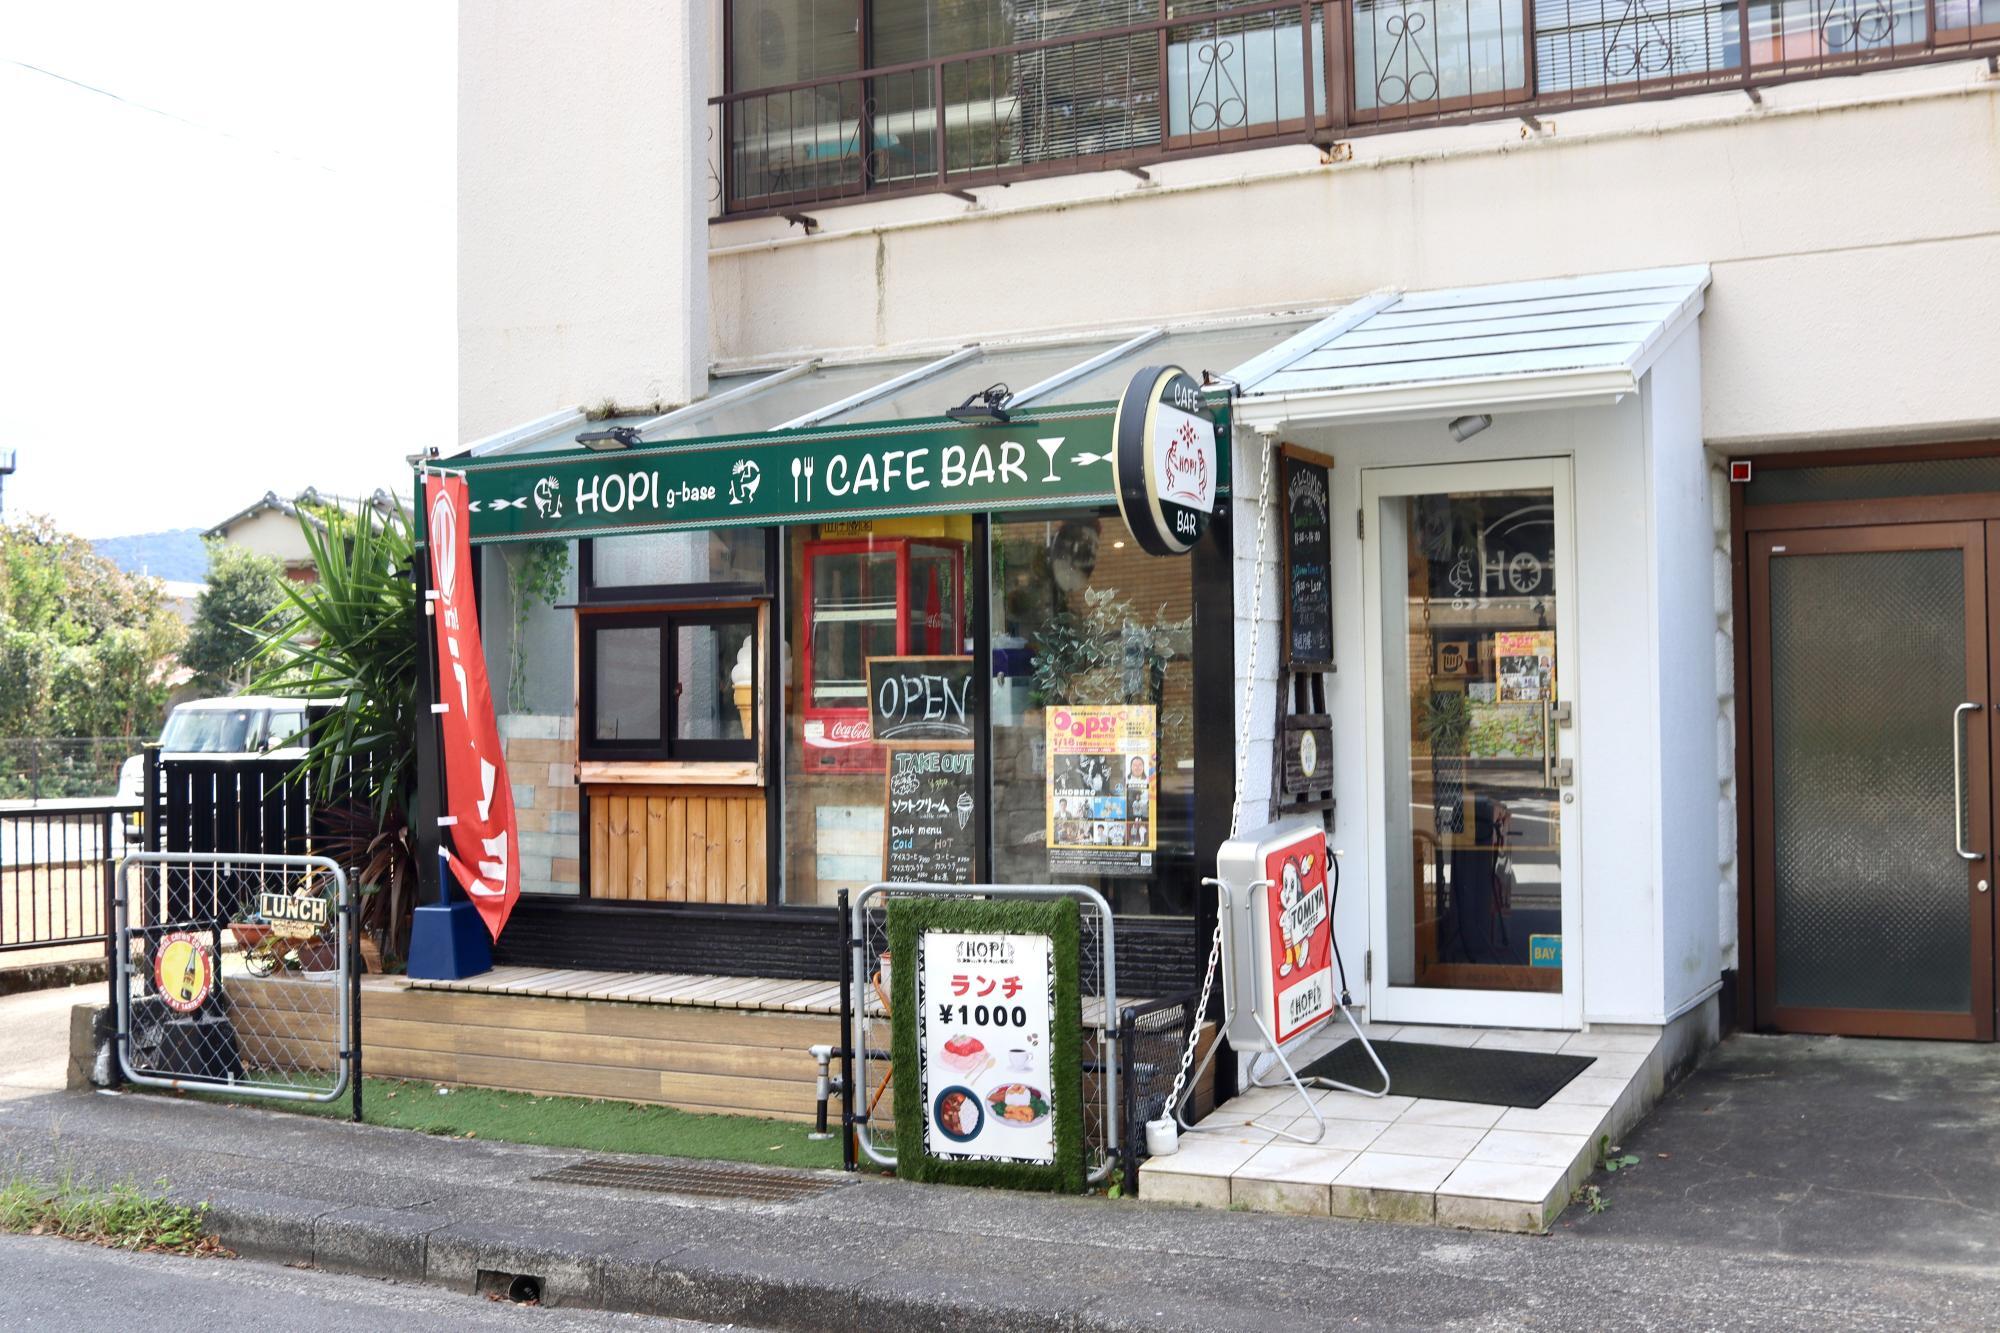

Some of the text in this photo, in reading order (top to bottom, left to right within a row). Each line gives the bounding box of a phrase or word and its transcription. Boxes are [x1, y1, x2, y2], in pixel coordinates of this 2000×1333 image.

[1174, 383, 1199, 412] CAFE
[826, 440, 1028, 496] CAFE BAR
[1179, 455, 1197, 477] HOPI
[576, 471, 716, 514] HOPI g-base
[1176, 510, 1197, 536] BAR
[879, 674, 972, 724] OPEN
[895, 752, 974, 776] TAKE OUT
[892, 824, 942, 837] Drink menu
[892, 837, 913, 850] Cold
[262, 895, 324, 922] LUNCH
[1291, 889, 1324, 926] TOMIYA
[1301, 911, 1319, 934] COFFEE
[966, 937, 1004, 957] HOPI
[1535, 947, 1556, 959] BAY
[951, 974, 1023, 999] ランチ
[1295, 984, 1317, 1016] HOPI
[939, 1004, 1027, 1028] ¥1000
